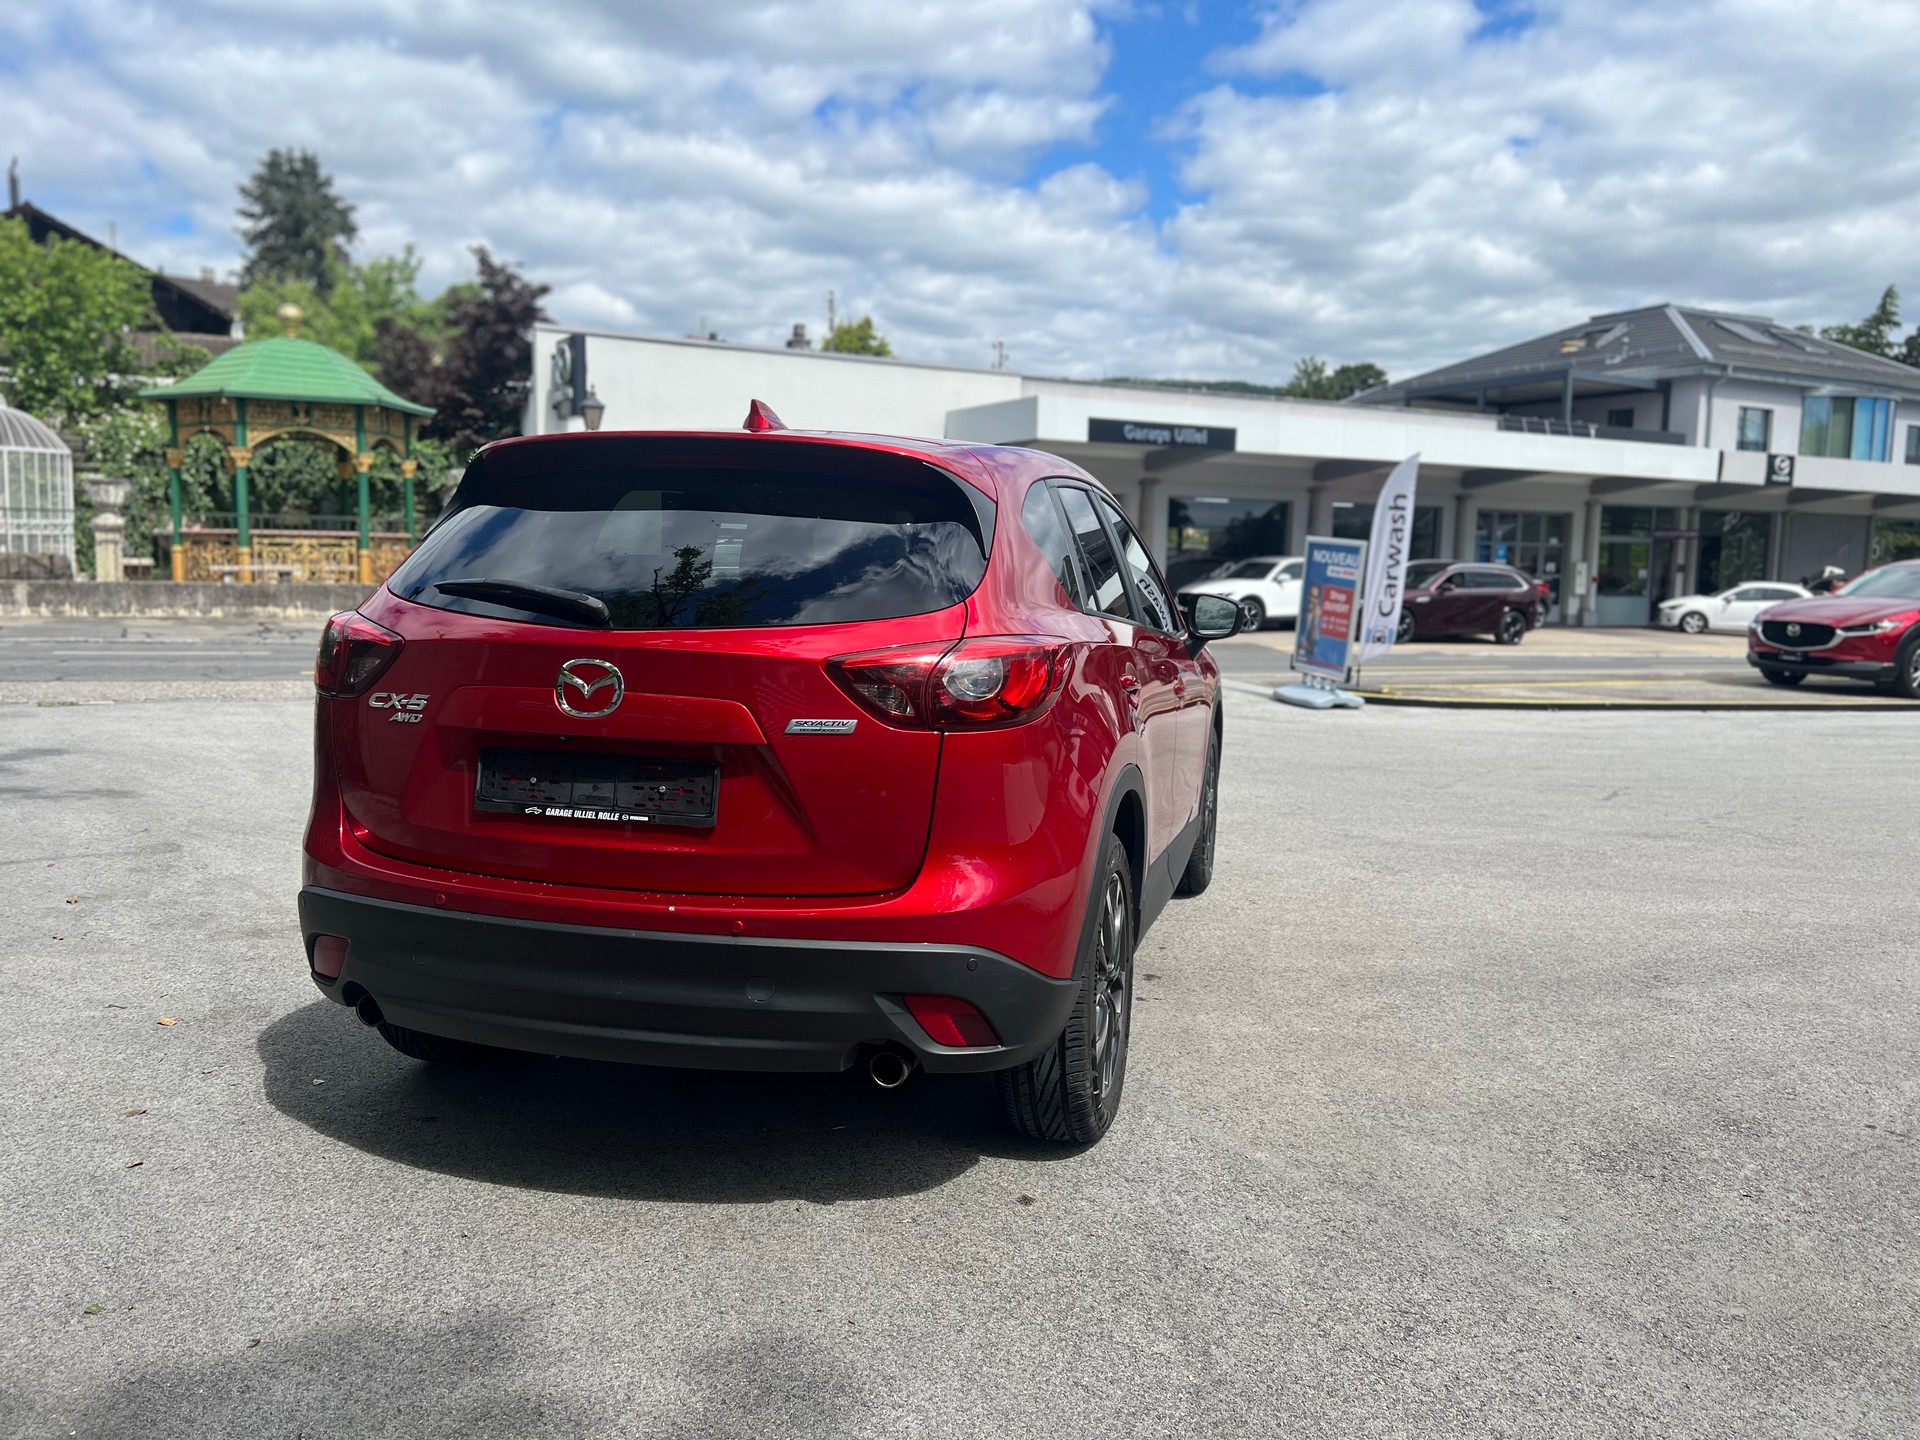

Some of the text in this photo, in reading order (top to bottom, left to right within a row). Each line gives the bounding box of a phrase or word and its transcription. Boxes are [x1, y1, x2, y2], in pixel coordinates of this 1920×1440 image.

[1123, 424, 1172, 444] Garage
[1312, 549, 1359, 567] NOUVEAU
[1378, 494, 1408, 617] Carwash
[368, 692, 431, 711] CX-5
[388, 712, 423, 723] AWD
[545, 808, 573, 817] GARAGE
[573, 810, 596, 819] ULLIEL
[597, 812, 620, 821] ROLLE
